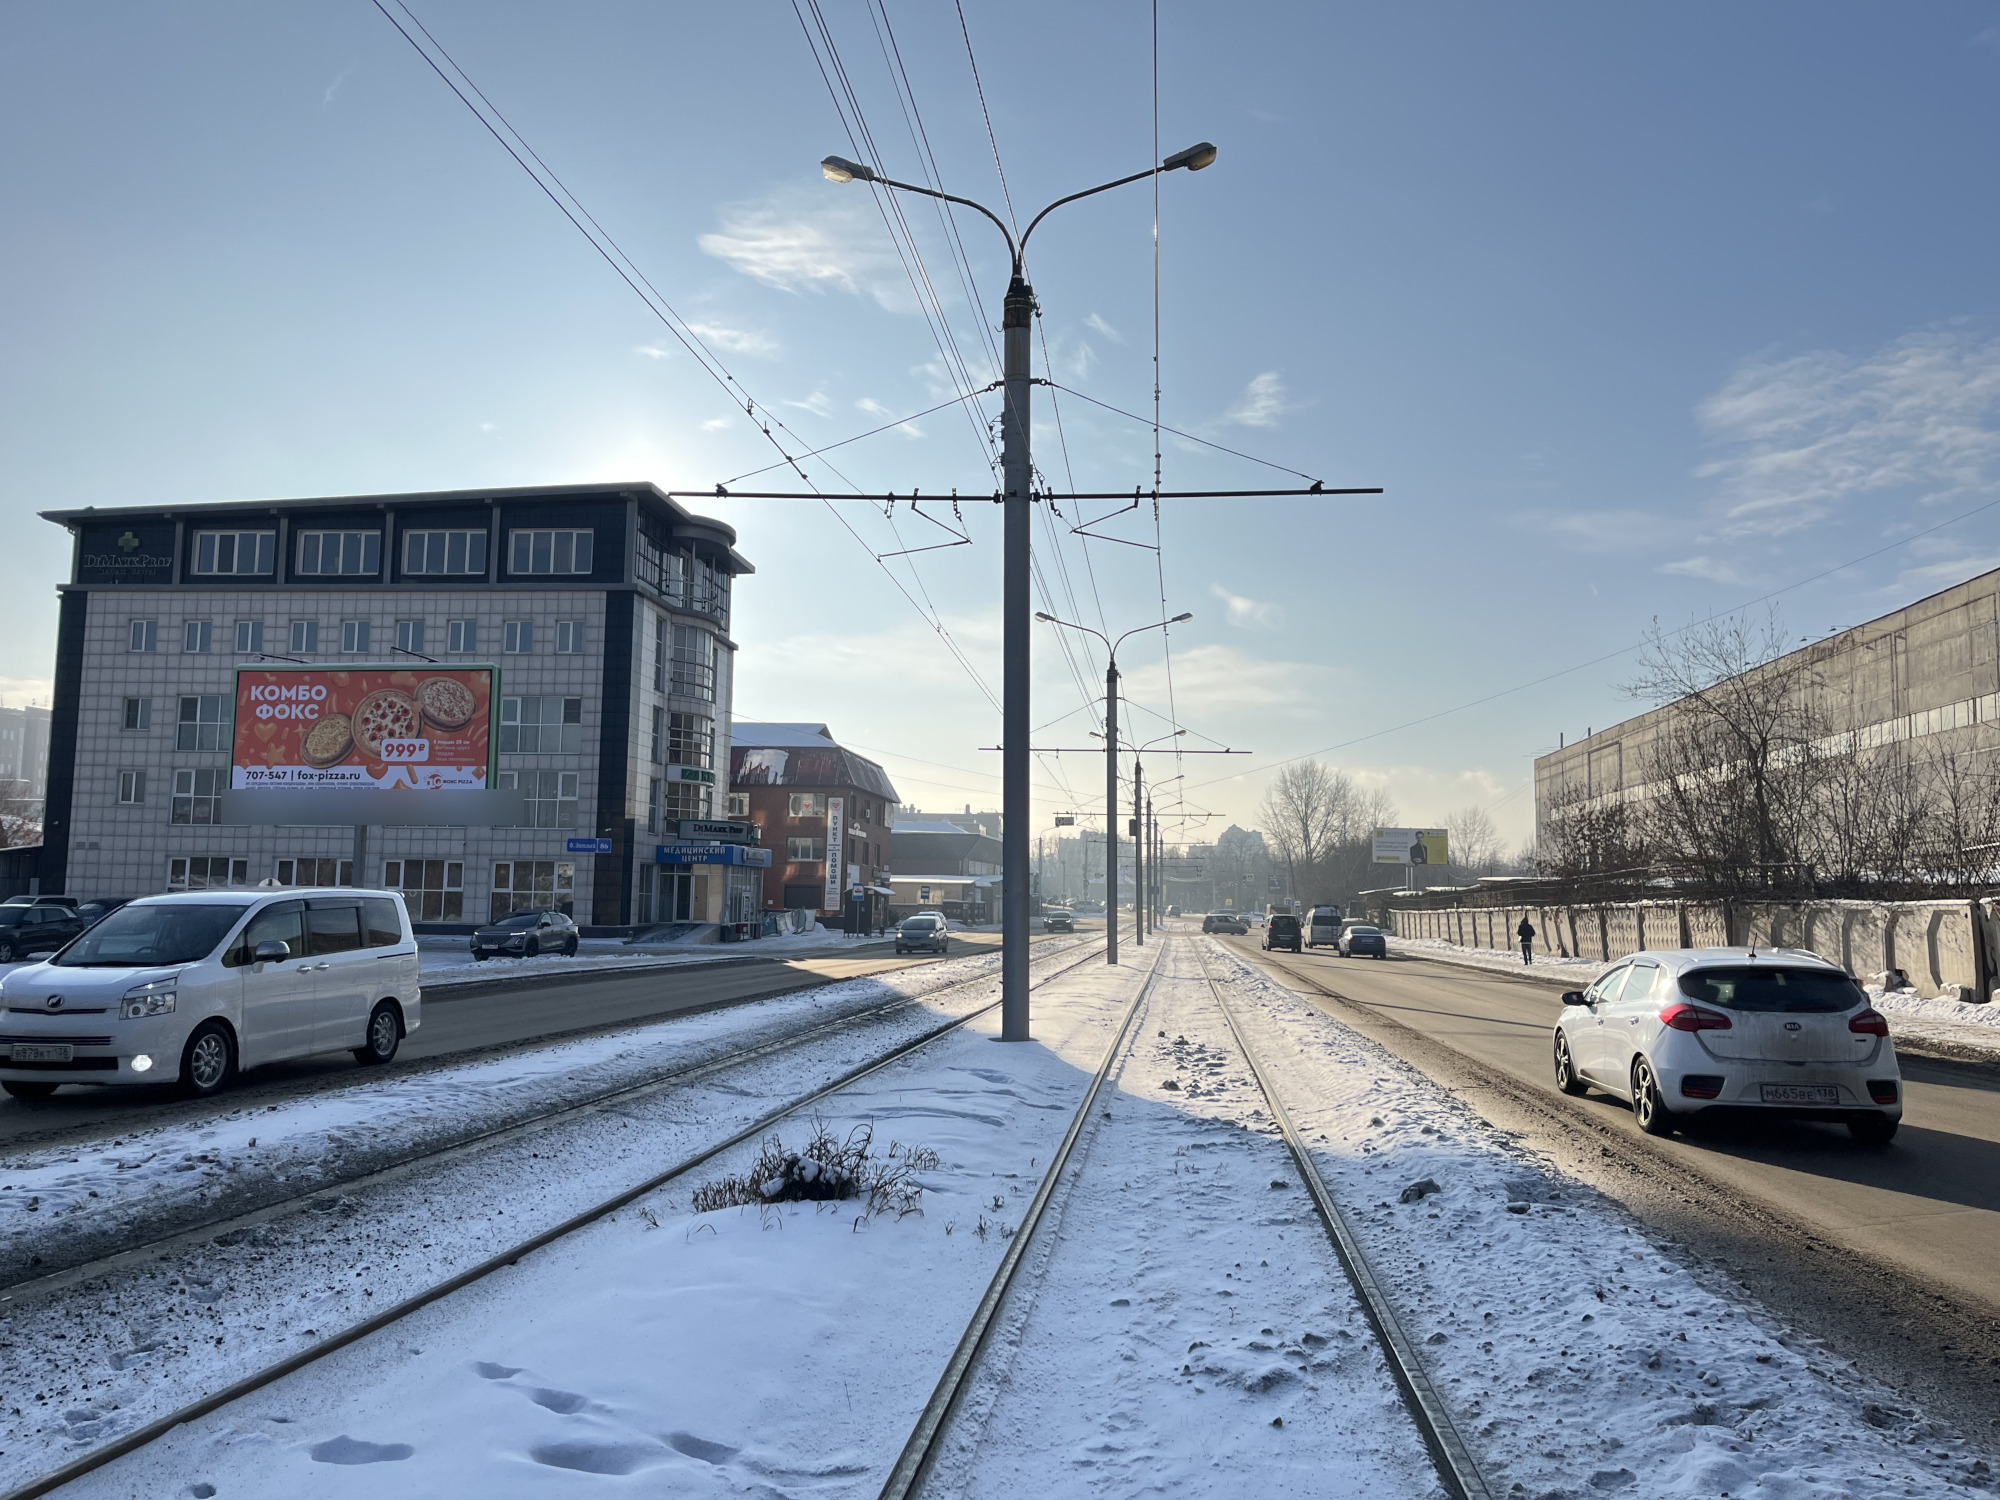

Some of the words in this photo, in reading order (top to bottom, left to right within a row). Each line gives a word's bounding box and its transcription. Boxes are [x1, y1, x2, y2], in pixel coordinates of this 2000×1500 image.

[250, 685, 327, 701] КОМБО
[255, 703, 320, 719] ФОКС
[245, 771, 287, 780] 707-547
[297, 770, 361, 781] fox-pizza.ru
[663, 846, 726, 855] МЕДИЦИНСКИЙ
[829, 852, 838, 885] ПОМОЩИ
